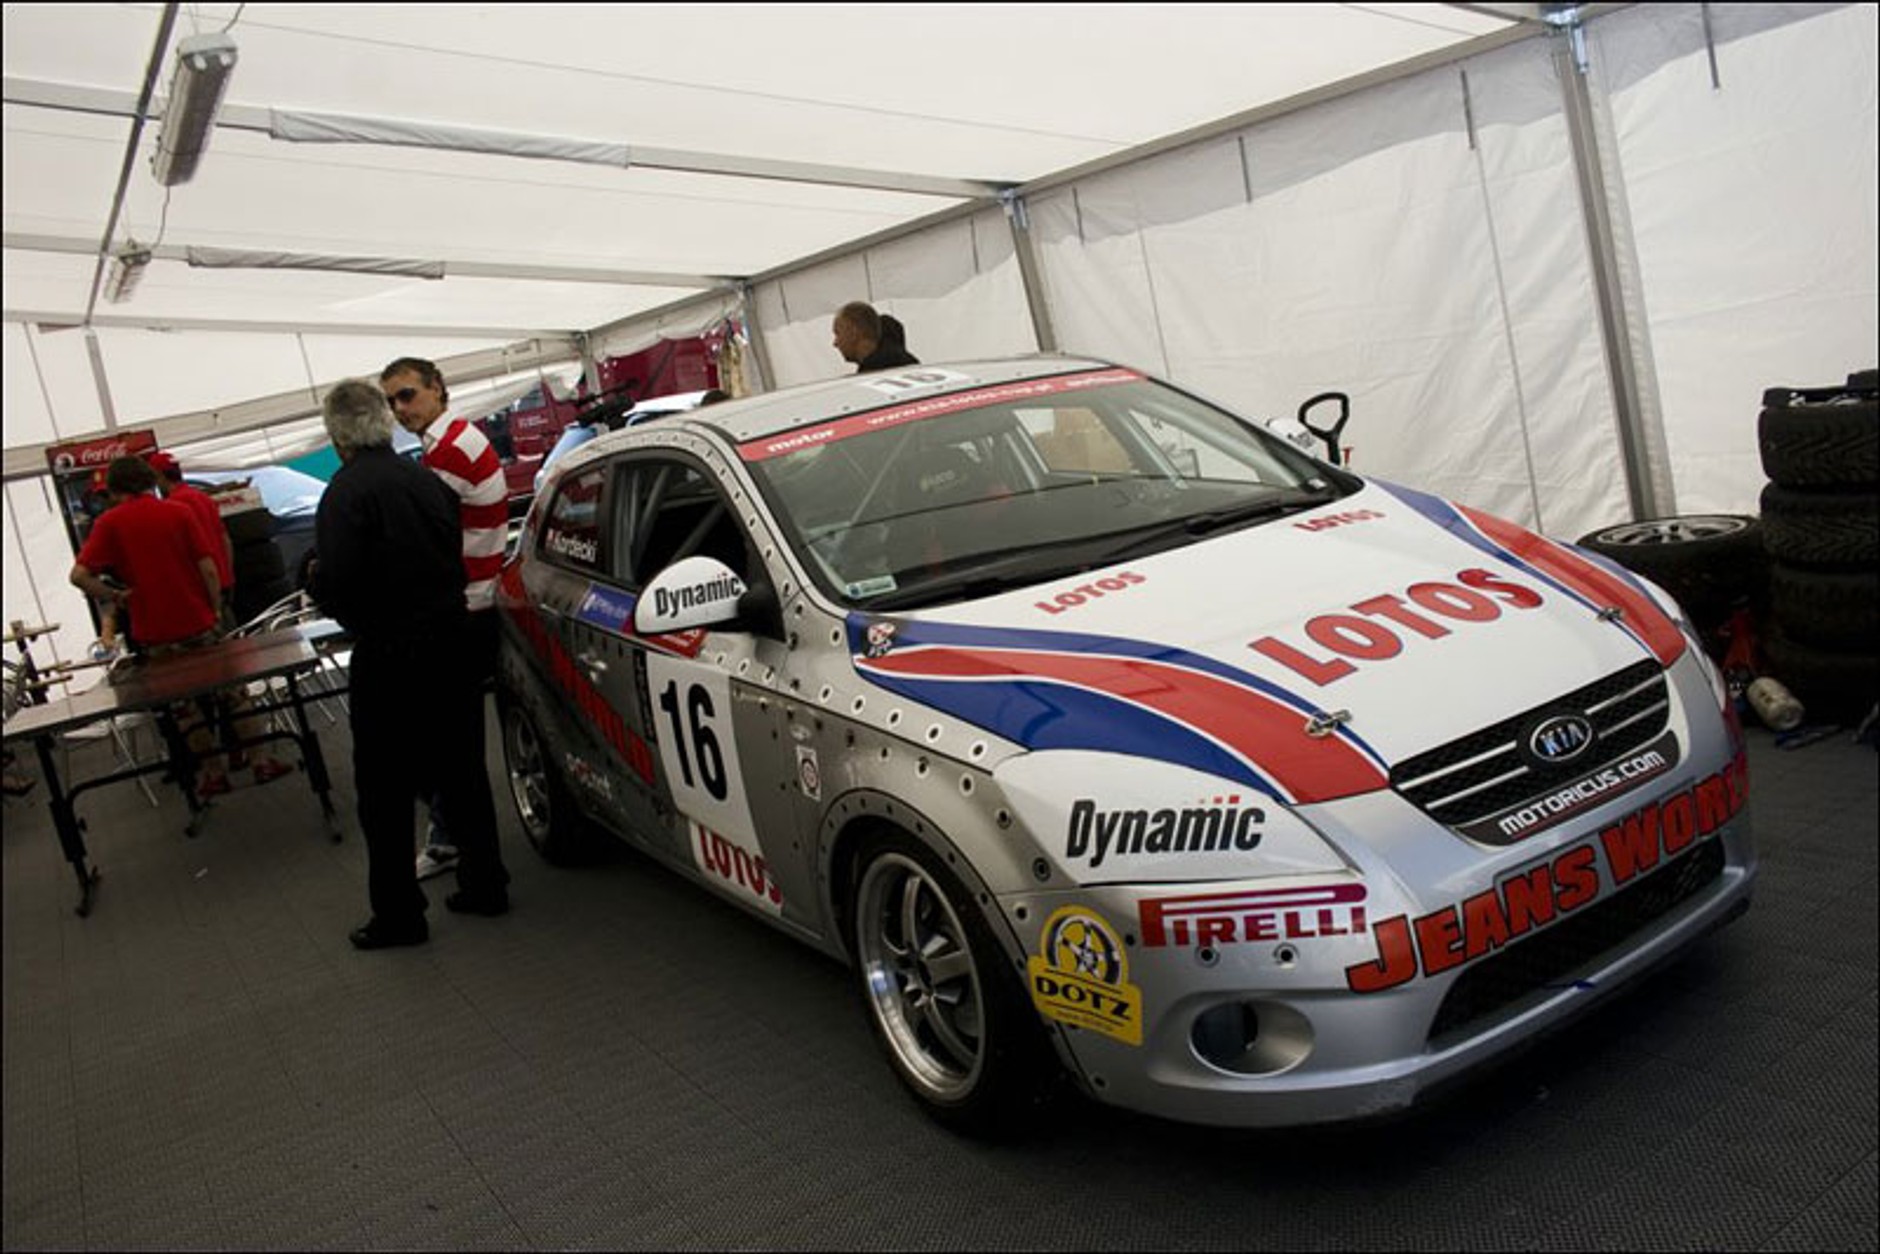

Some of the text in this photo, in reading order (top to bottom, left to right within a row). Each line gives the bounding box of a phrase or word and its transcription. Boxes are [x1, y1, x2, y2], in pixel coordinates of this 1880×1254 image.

[767, 429, 836, 453] motor
[1293, 509, 1385, 532] LOTOS
[655, 572, 741, 619] Dynamic
[1035, 571, 1147, 615] LOTOS
[1248, 568, 1545, 687] LOTOS
[660, 679, 728, 802] 16
[1540, 723, 1585, 757] KIA
[1498, 751, 1666, 836] MOTORICUS.COM
[698, 823, 784, 905] LOTOS
[1066, 796, 1266, 868] Dynamic
[1138, 883, 1367, 947] PIRELLI
[1345, 844, 1600, 994] JEANS
[1035, 976, 1132, 1021] DOTZ
